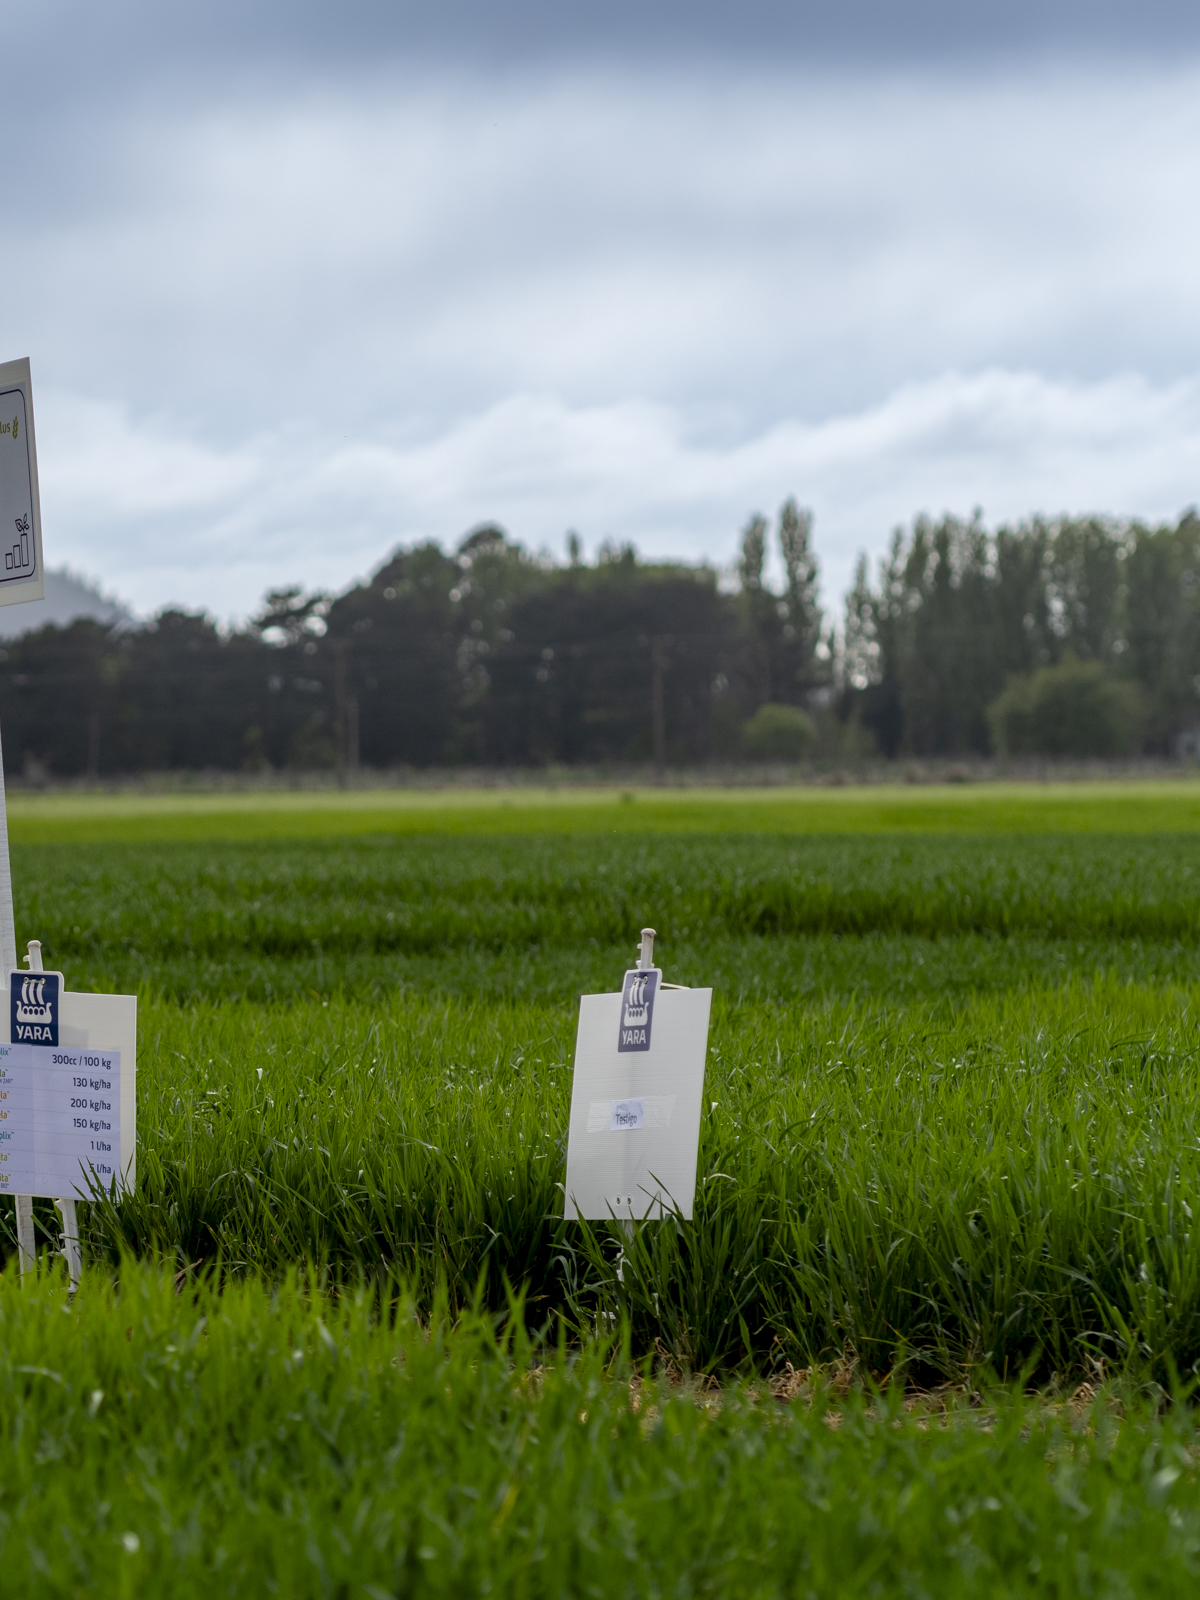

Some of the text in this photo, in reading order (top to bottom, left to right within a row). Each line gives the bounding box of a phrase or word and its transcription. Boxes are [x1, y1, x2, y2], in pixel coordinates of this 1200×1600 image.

[16, 1025, 53, 1041] YARA
[622, 1029, 647, 1045] YARA
[52, 1054, 77, 1066] 300cc
[84, 1056, 100, 1067] 100
[101, 1058, 112, 1070] kg
[73, 1077, 112, 1091] 130 kg/ha
[70, 1098, 112, 1112] 200 kg/ha
[73, 1118, 112, 1132] 150 kg/ha
[616, 1112, 638, 1127] Testigo
[90, 1140, 94, 1150] 1
